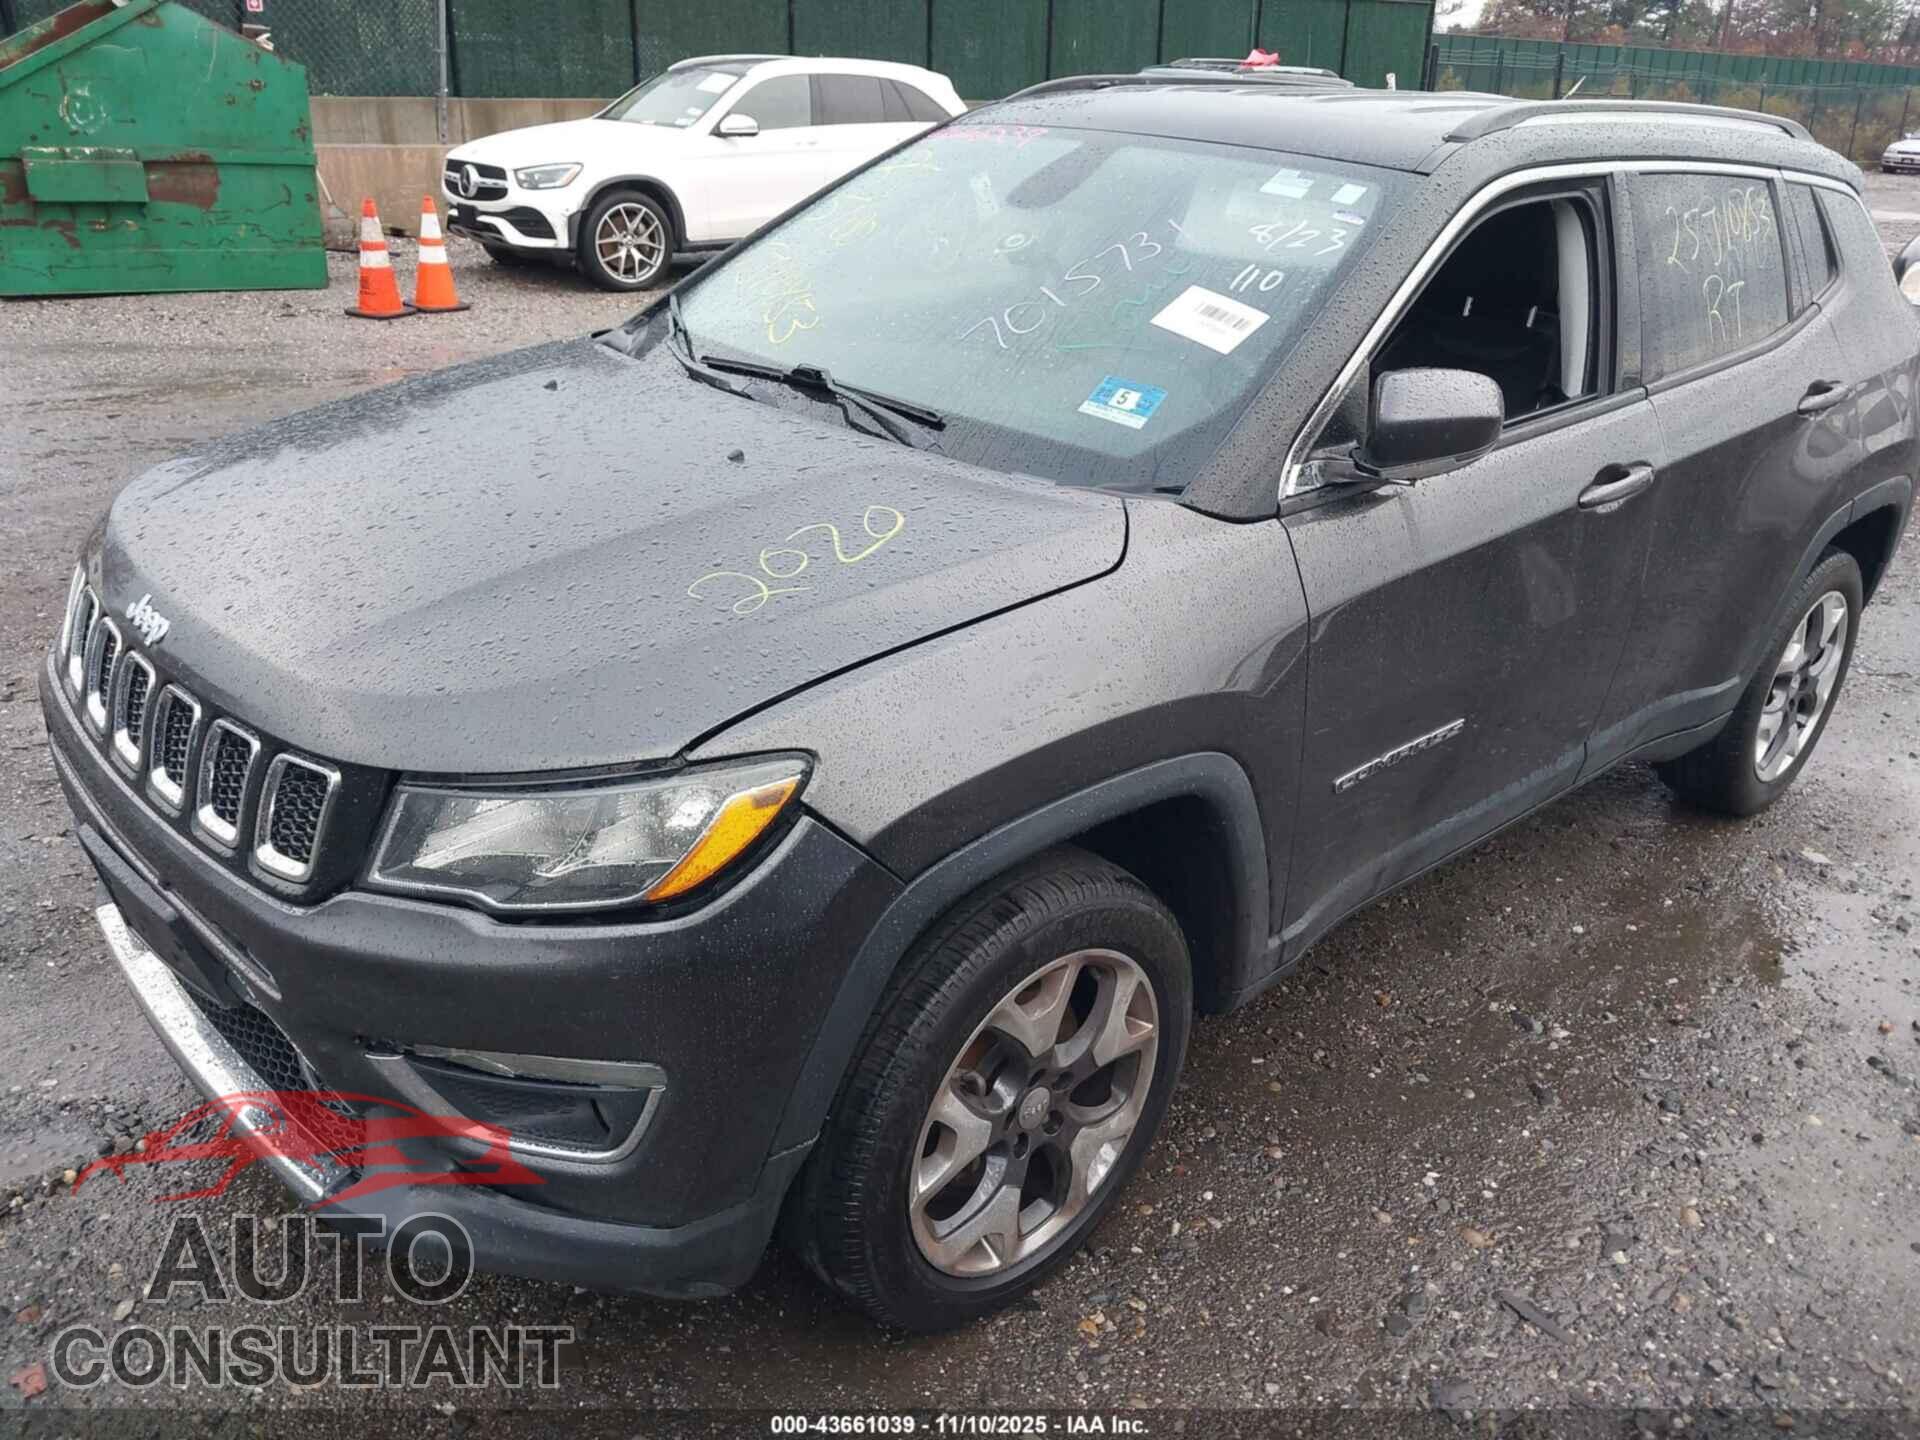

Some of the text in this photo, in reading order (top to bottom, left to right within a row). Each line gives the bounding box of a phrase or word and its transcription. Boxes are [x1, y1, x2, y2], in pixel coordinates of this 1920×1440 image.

[1229, 263, 1286, 293] 110
[1702, 274, 1746, 344] RT
[1116, 391, 1131, 406] 5
[687, 505, 905, 614] 2020
[126, 593, 171, 646] Jeep
